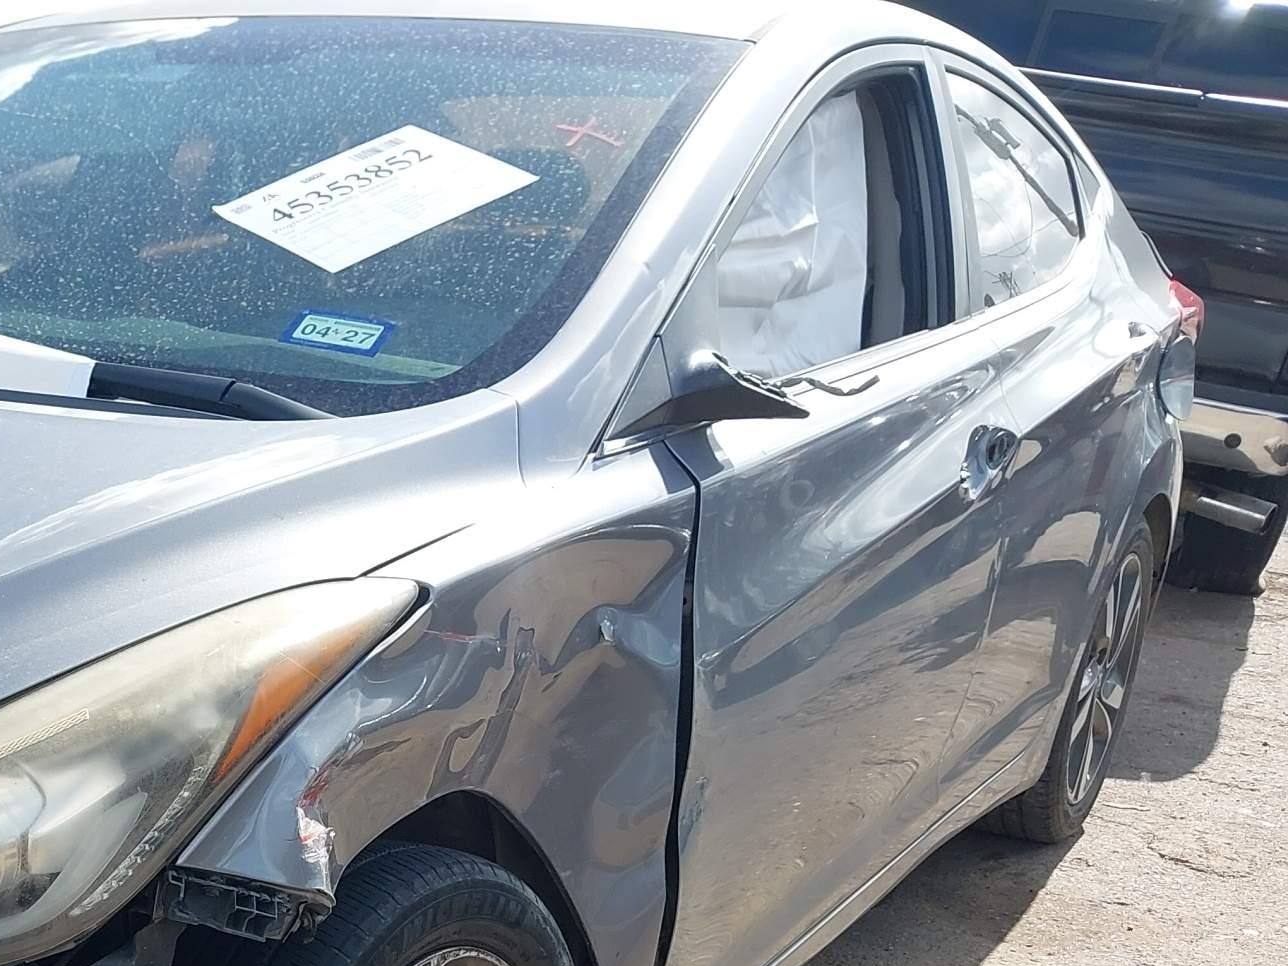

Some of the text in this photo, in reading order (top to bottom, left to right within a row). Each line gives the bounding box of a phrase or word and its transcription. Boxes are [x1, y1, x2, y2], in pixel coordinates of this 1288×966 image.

[272, 148, 434, 222] 45353852
[300, 323, 331, 338] 04
[342, 329, 376, 344] 27
